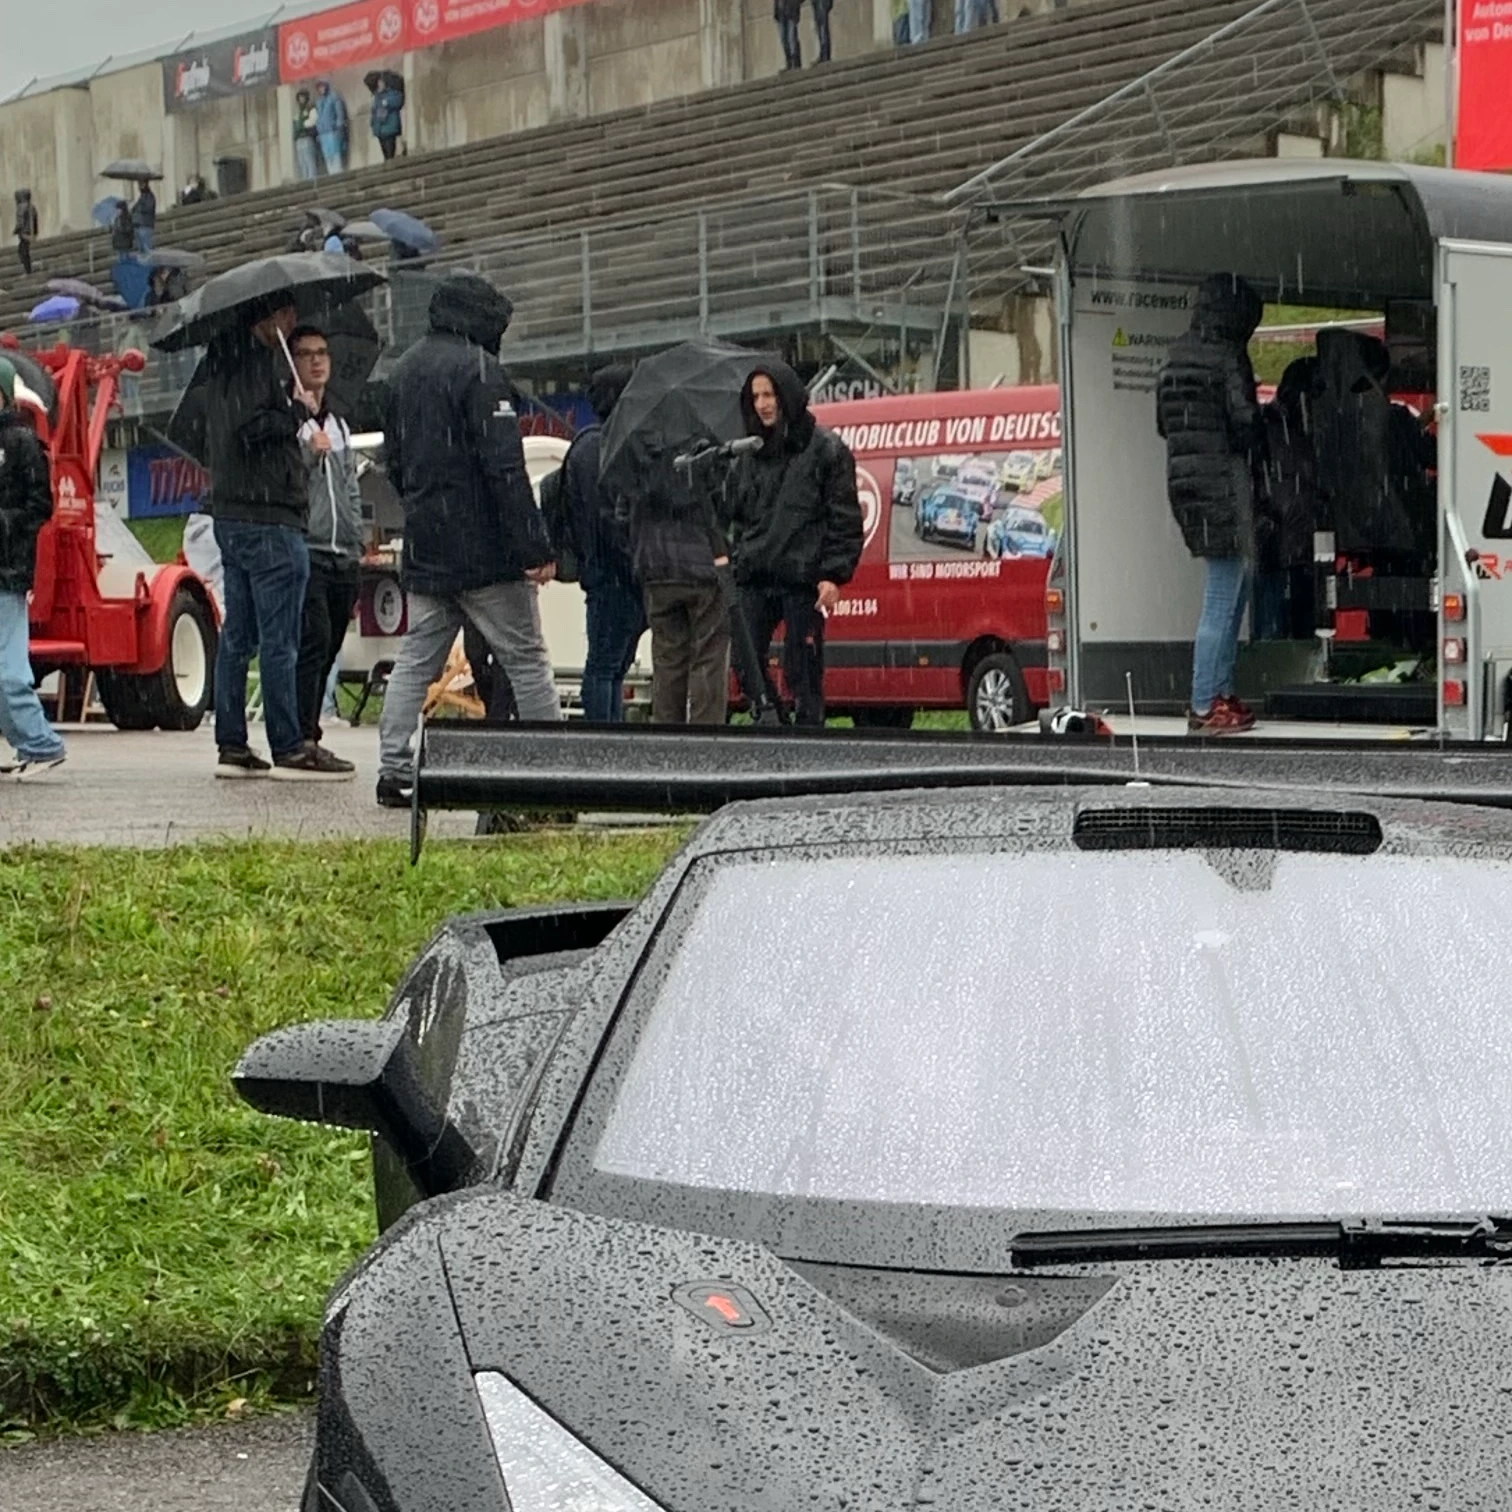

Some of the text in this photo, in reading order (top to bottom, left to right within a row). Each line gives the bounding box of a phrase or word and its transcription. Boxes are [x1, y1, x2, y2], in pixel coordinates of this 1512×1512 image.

[832, 420, 941, 451] MOBILCLUB
[945, 416, 987, 445] VON
[889, 560, 1001, 580] WIR SIND MOTORSPORT
